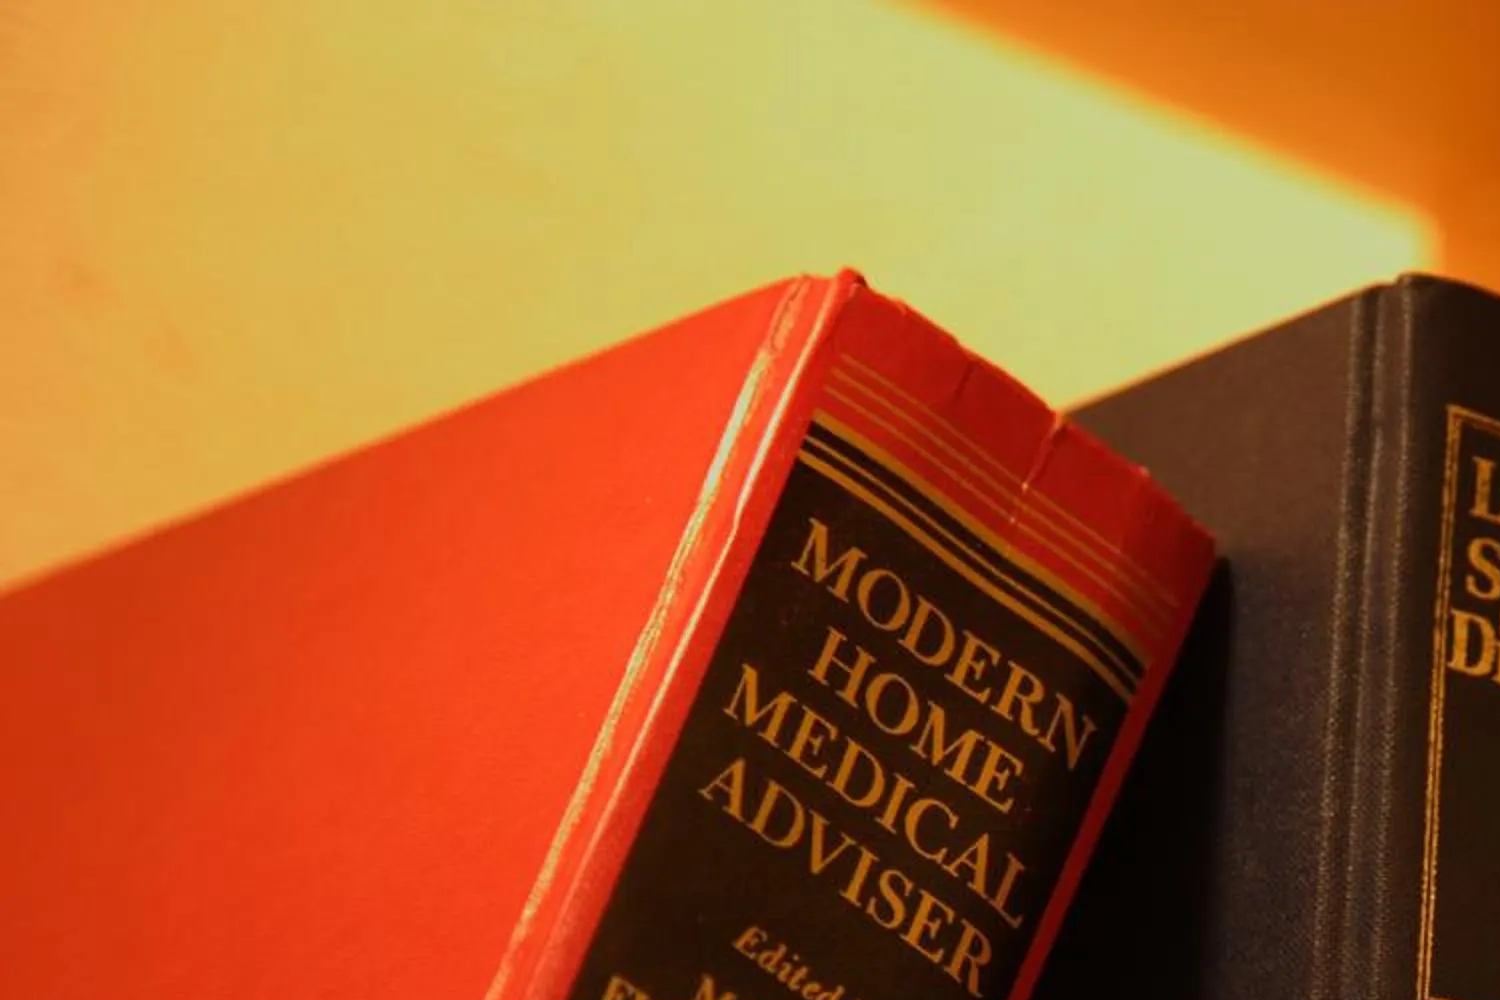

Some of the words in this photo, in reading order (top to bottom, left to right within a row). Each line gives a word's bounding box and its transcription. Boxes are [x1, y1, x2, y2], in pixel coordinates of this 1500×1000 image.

[790, 517, 1097, 771] MODERN
[808, 626, 1024, 813] HOME
[699, 757, 994, 998] ADVISER
[723, 664, 1026, 928] MEDICAL
